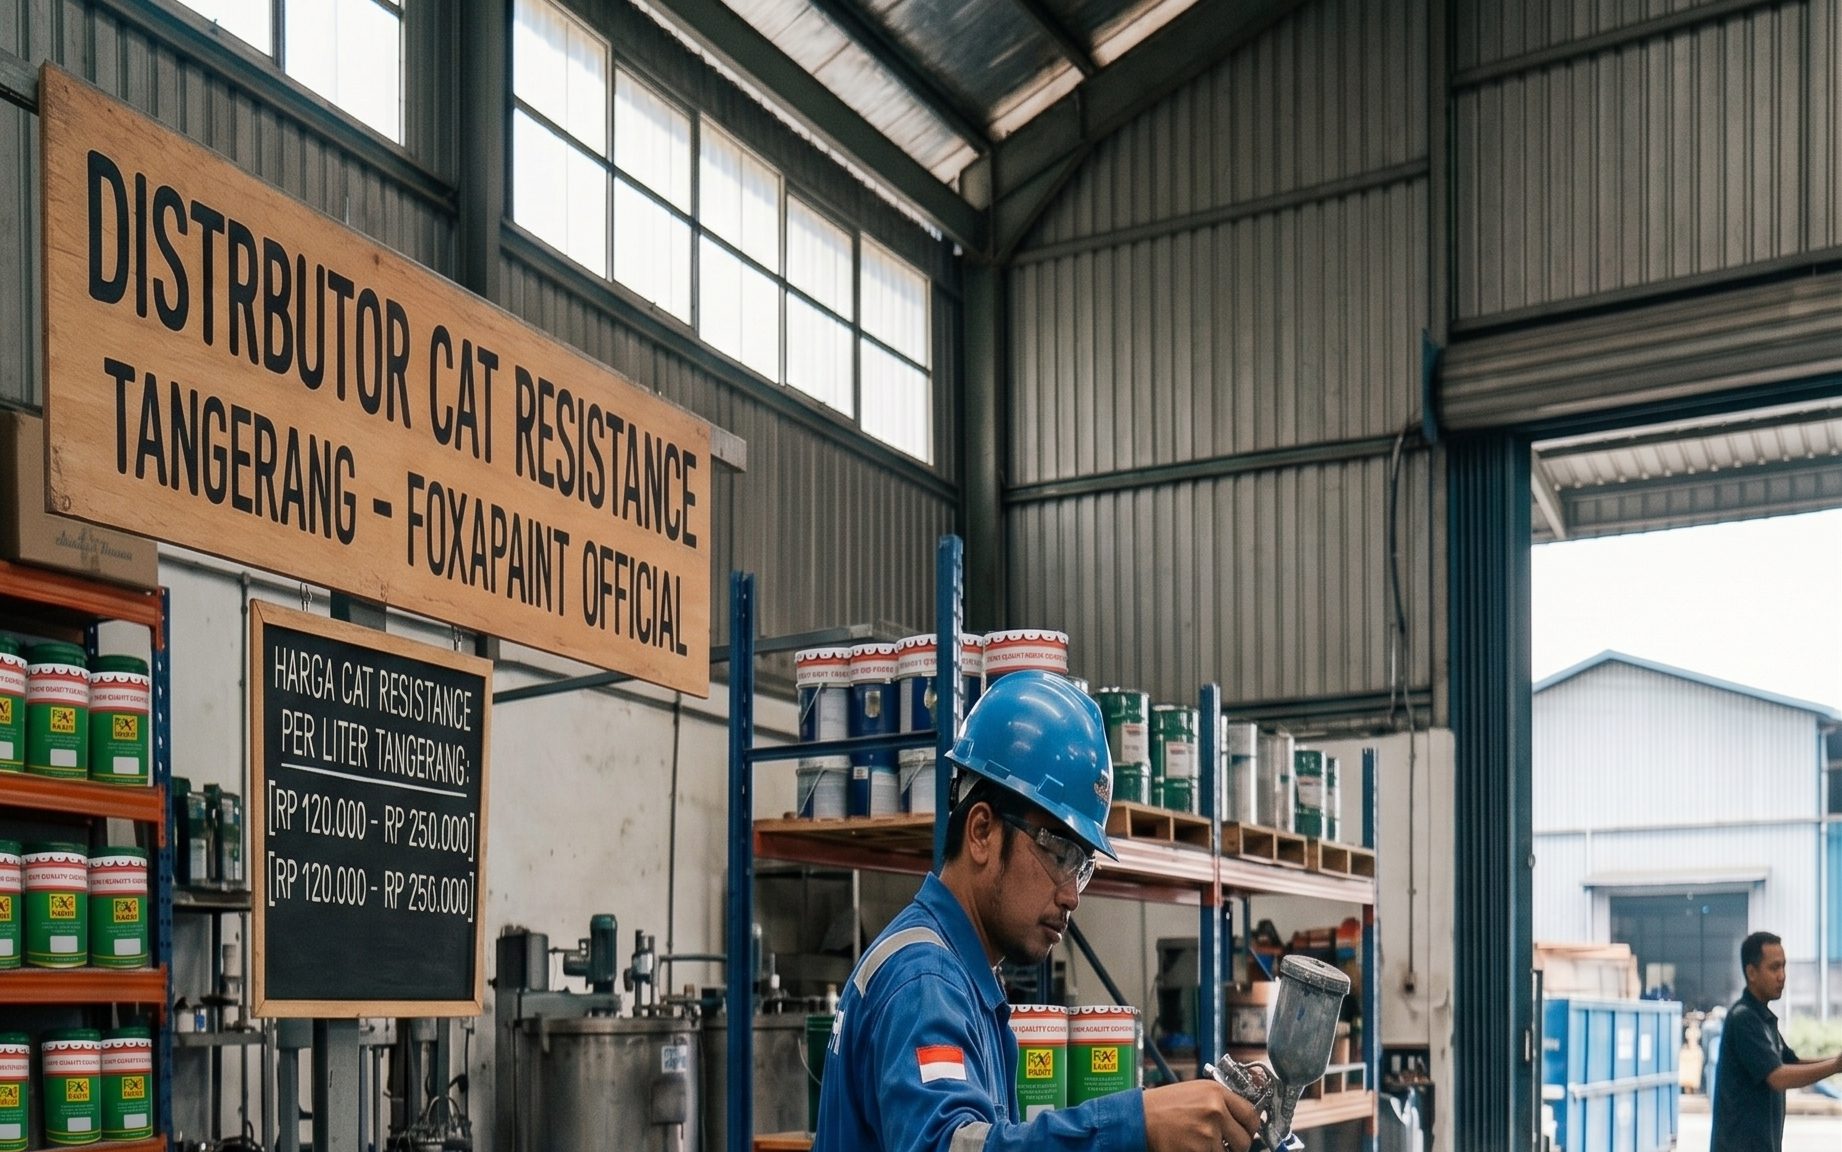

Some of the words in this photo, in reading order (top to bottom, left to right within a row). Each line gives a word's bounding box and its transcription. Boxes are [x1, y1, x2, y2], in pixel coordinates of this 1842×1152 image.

[87, 149, 411, 430] DISTRBUTOR
[429, 325, 499, 464] CAT
[514, 365, 698, 549] RESISTANCE
[104, 357, 356, 546] TANGERANG
[373, 496, 394, 519] -
[407, 472, 567, 617] FOXAPAINT
[581, 541, 689, 658] OFFICIAL
[275, 646, 335, 702] HARGA
[342, 661, 374, 709] CAT
[379, 669, 472, 732] RESISTANCE
[281, 709, 315, 759] PER
[323, 717, 369, 769] LITER
[376, 728, 470, 786] TANGERANG:
[268, 780, 298, 836] [RP
[302, 793, 367, 841] 120.000
[384, 804, 405, 845] RP
[409, 808, 475, 863] 250.000]
[268, 851, 298, 907] [RP
[302, 862, 367, 906] 120.000
[384, 870, 405, 910] RP
